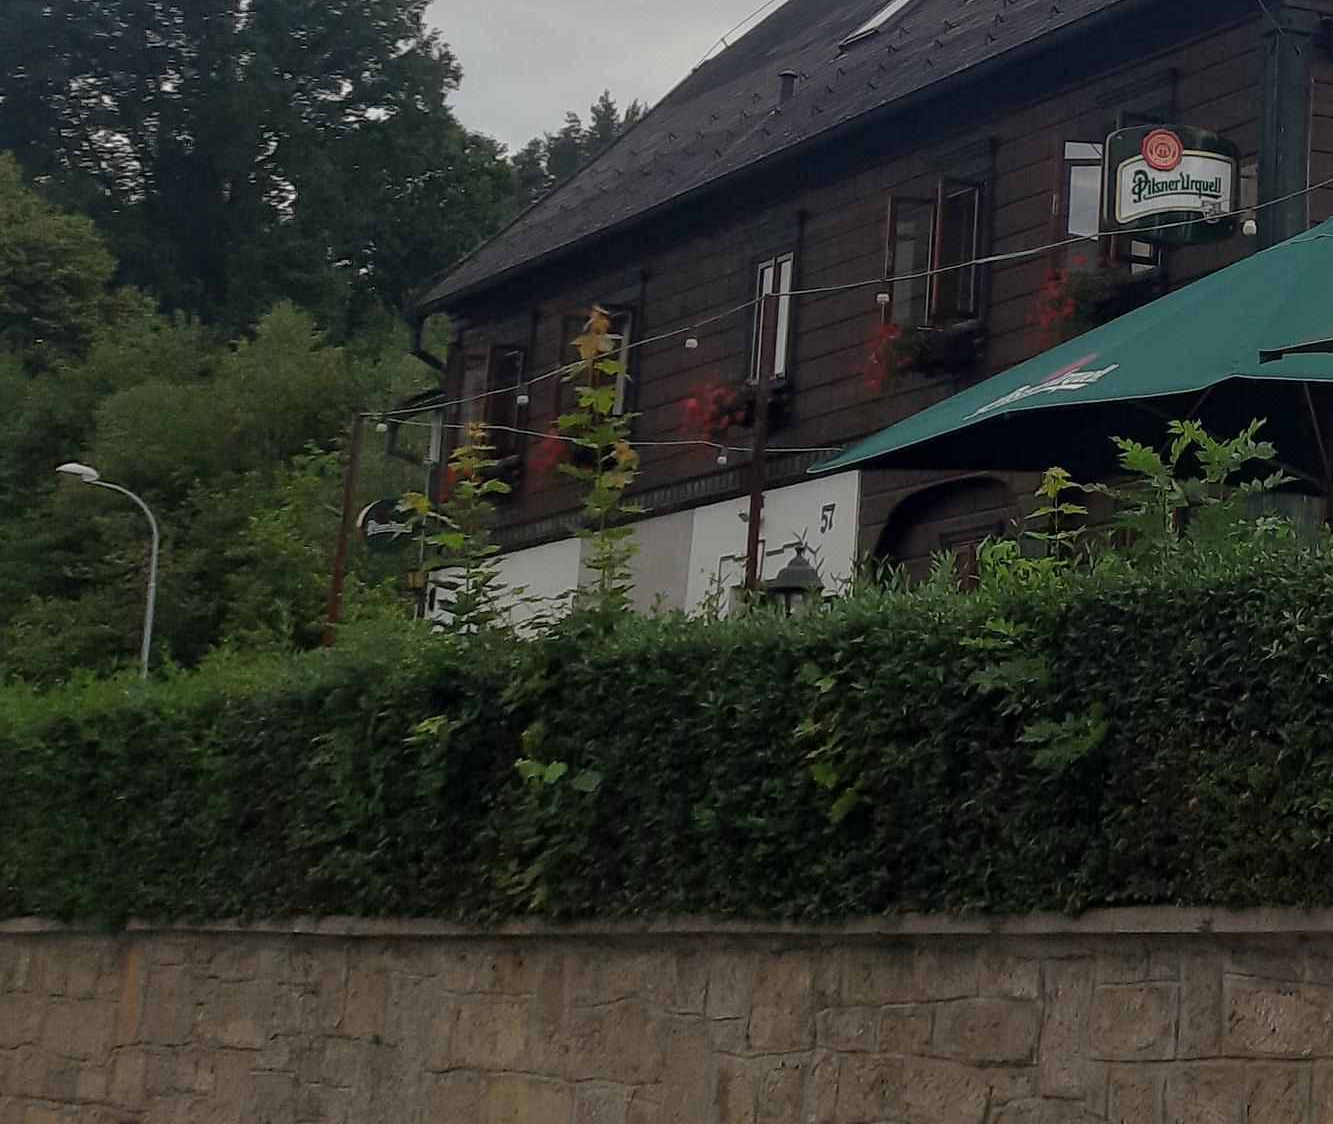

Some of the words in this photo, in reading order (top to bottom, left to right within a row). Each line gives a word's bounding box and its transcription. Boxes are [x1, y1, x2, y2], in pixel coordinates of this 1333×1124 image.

[1131, 169, 1181, 204] Pilsner
[1179, 172, 1222, 199] Urquell
[820, 503, 836, 534] 57
